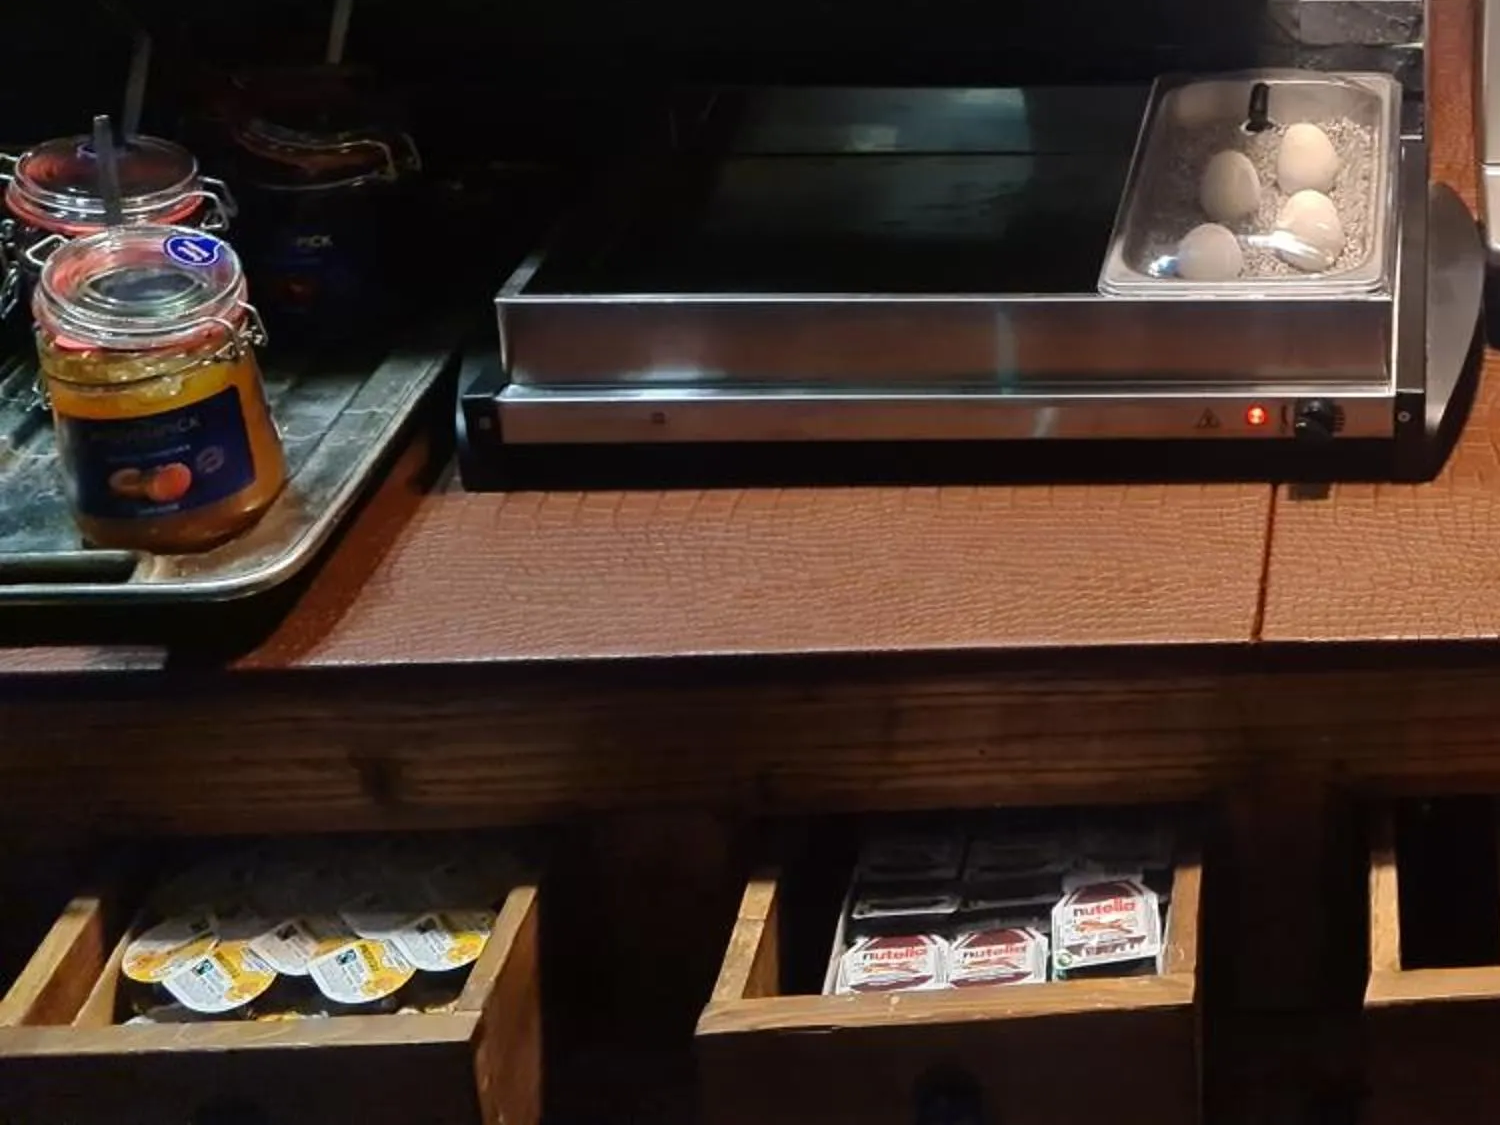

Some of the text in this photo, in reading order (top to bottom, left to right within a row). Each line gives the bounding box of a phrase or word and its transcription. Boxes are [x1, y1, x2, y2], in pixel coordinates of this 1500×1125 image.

[1072, 897, 1137, 917] nutella
[862, 944, 928, 961] nutella
[962, 943, 1028, 961] nutella
